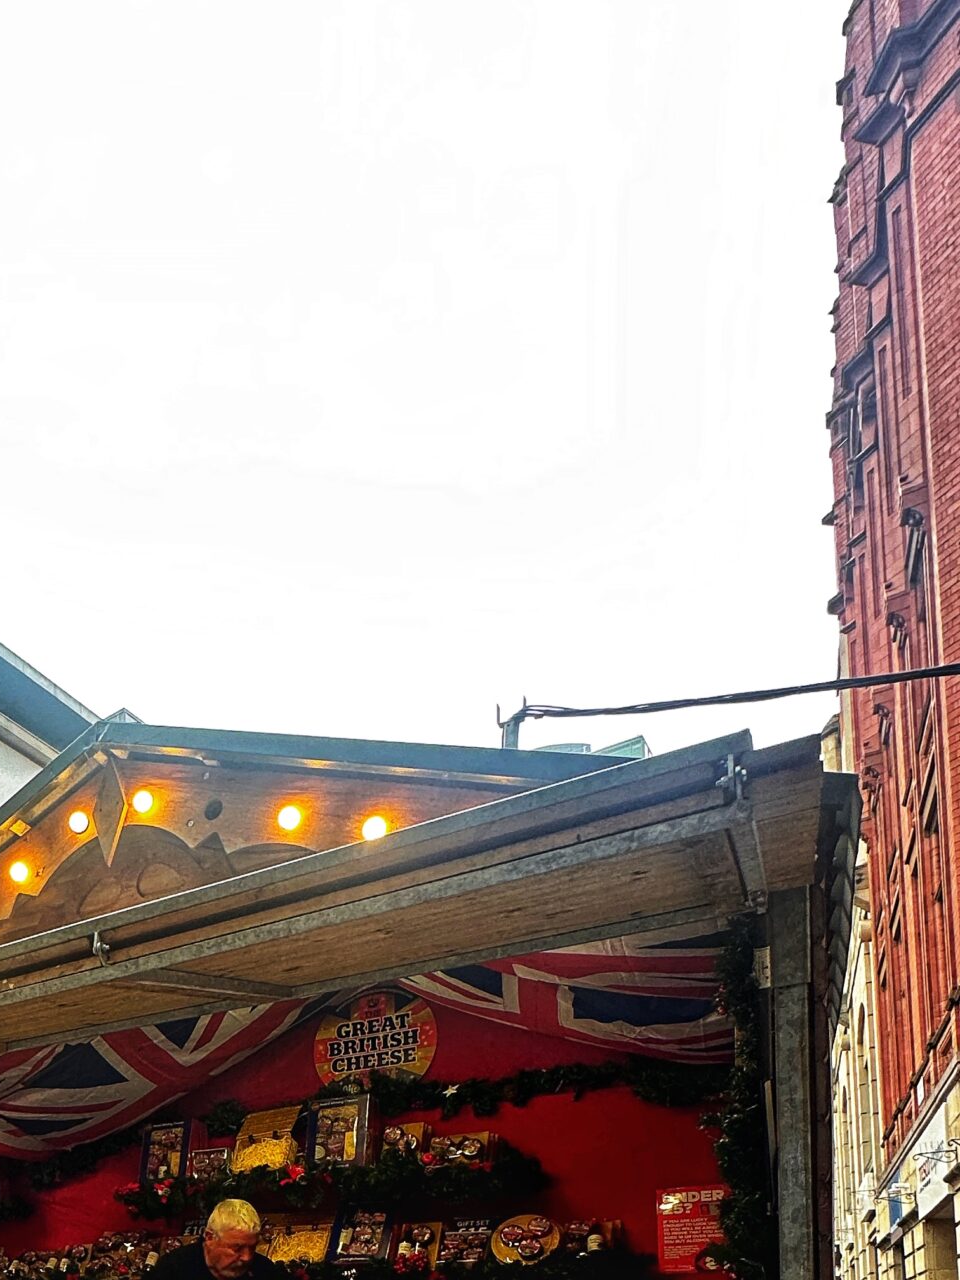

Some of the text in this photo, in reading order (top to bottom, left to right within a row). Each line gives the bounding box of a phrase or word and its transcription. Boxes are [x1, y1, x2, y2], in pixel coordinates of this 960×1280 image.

[335, 1012, 412, 1040] GREAT
[327, 1028, 420, 1058] BRITISH
[331, 1046, 418, 1075] CHEESE
